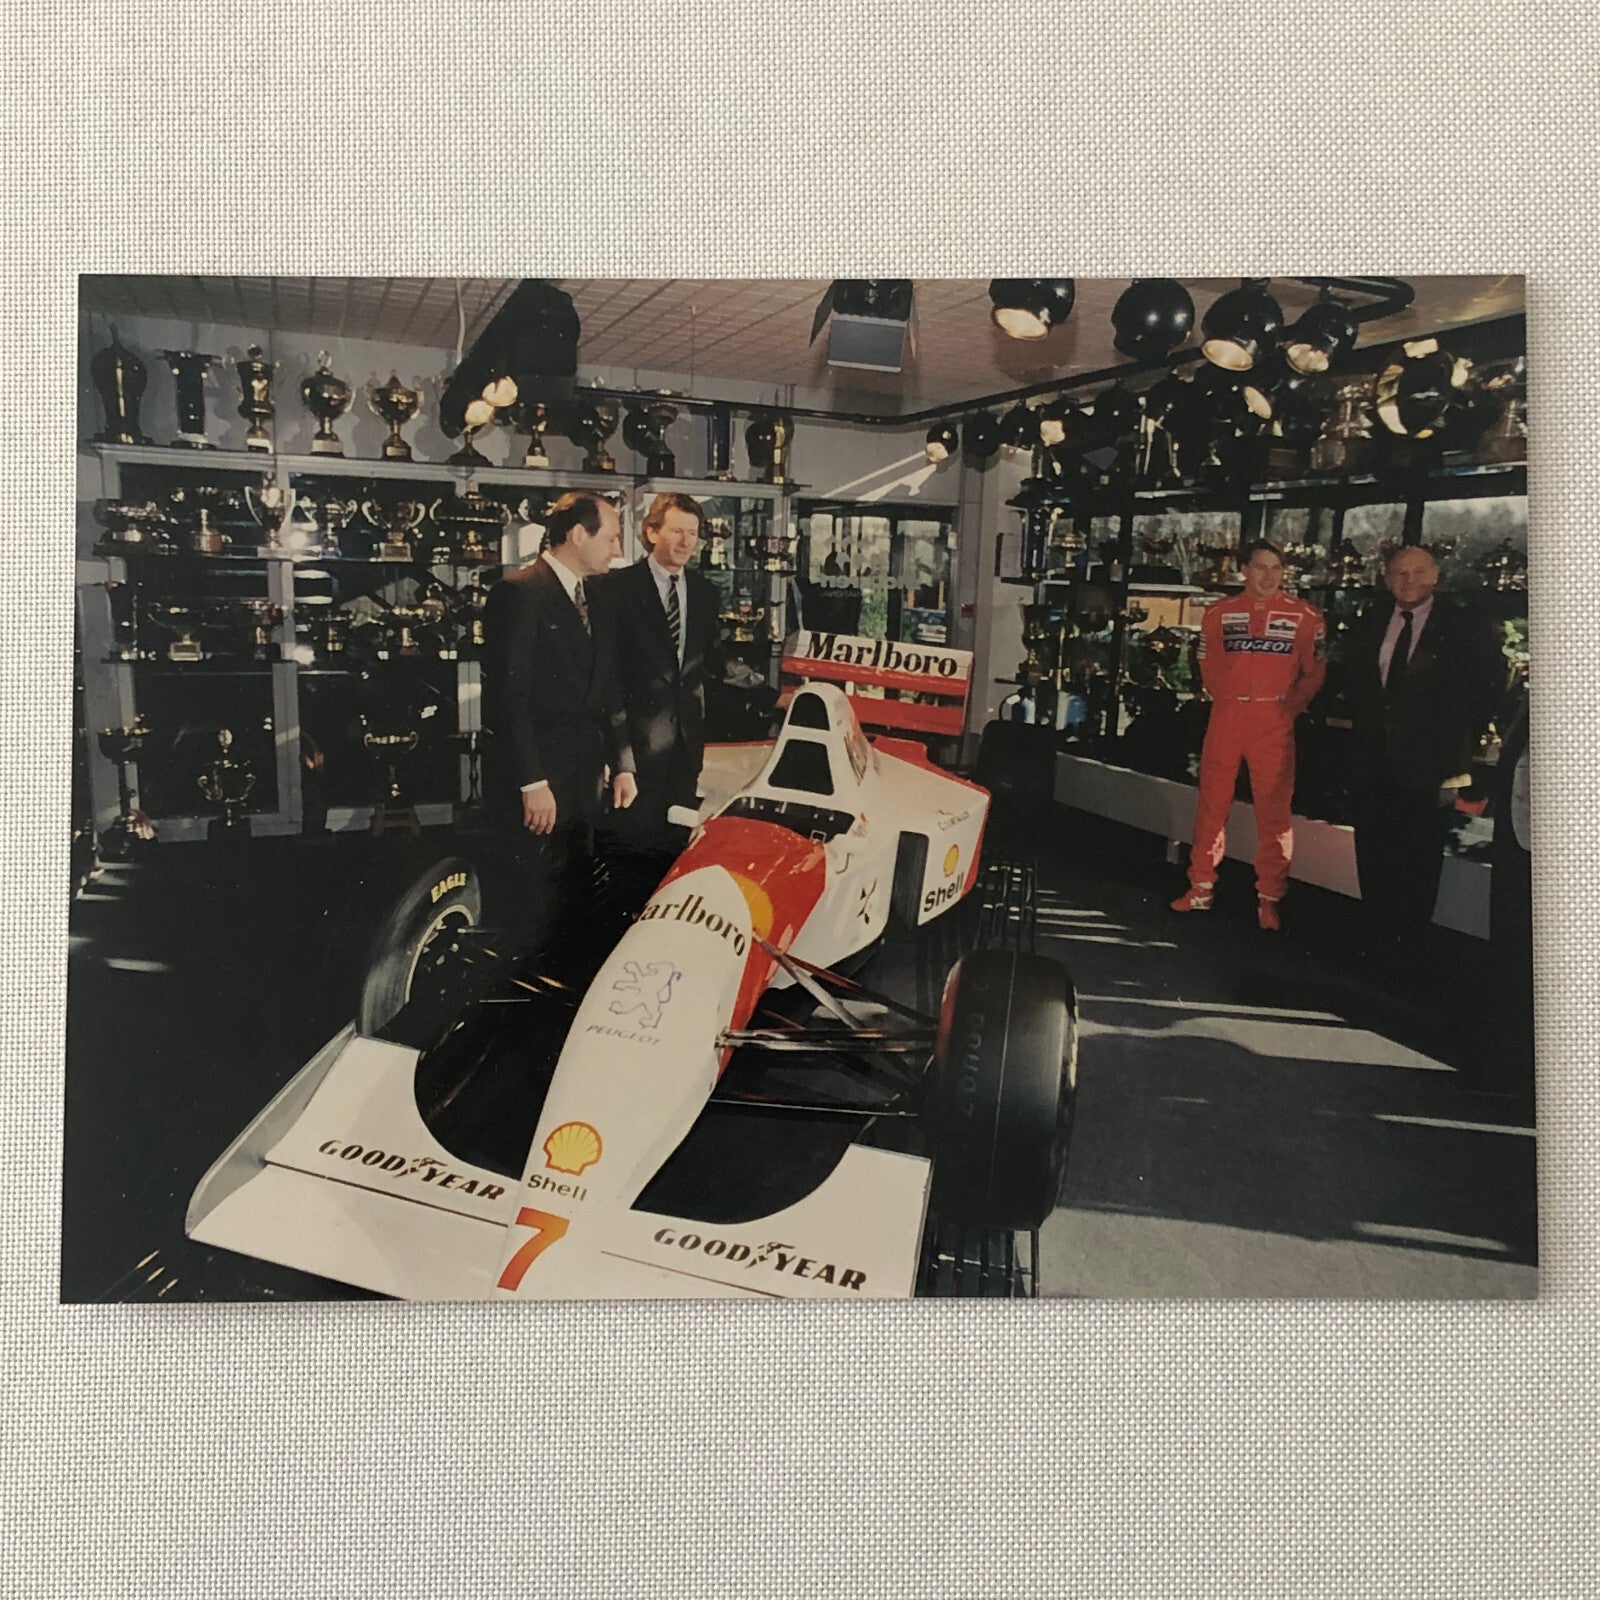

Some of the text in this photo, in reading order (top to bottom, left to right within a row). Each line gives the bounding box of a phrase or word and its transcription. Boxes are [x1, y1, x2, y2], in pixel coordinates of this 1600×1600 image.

[805, 632, 958, 677] Marlboro
[1225, 639, 1293, 653] PEUGEOT
[431, 872, 467, 903] EAGLE
[923, 871, 965, 913] Shell
[640, 894, 747, 958] arlboro
[586, 1023, 661, 1046] PEUGEOT
[527, 1173, 588, 1202] Shell
[496, 1206, 571, 1292] 7
